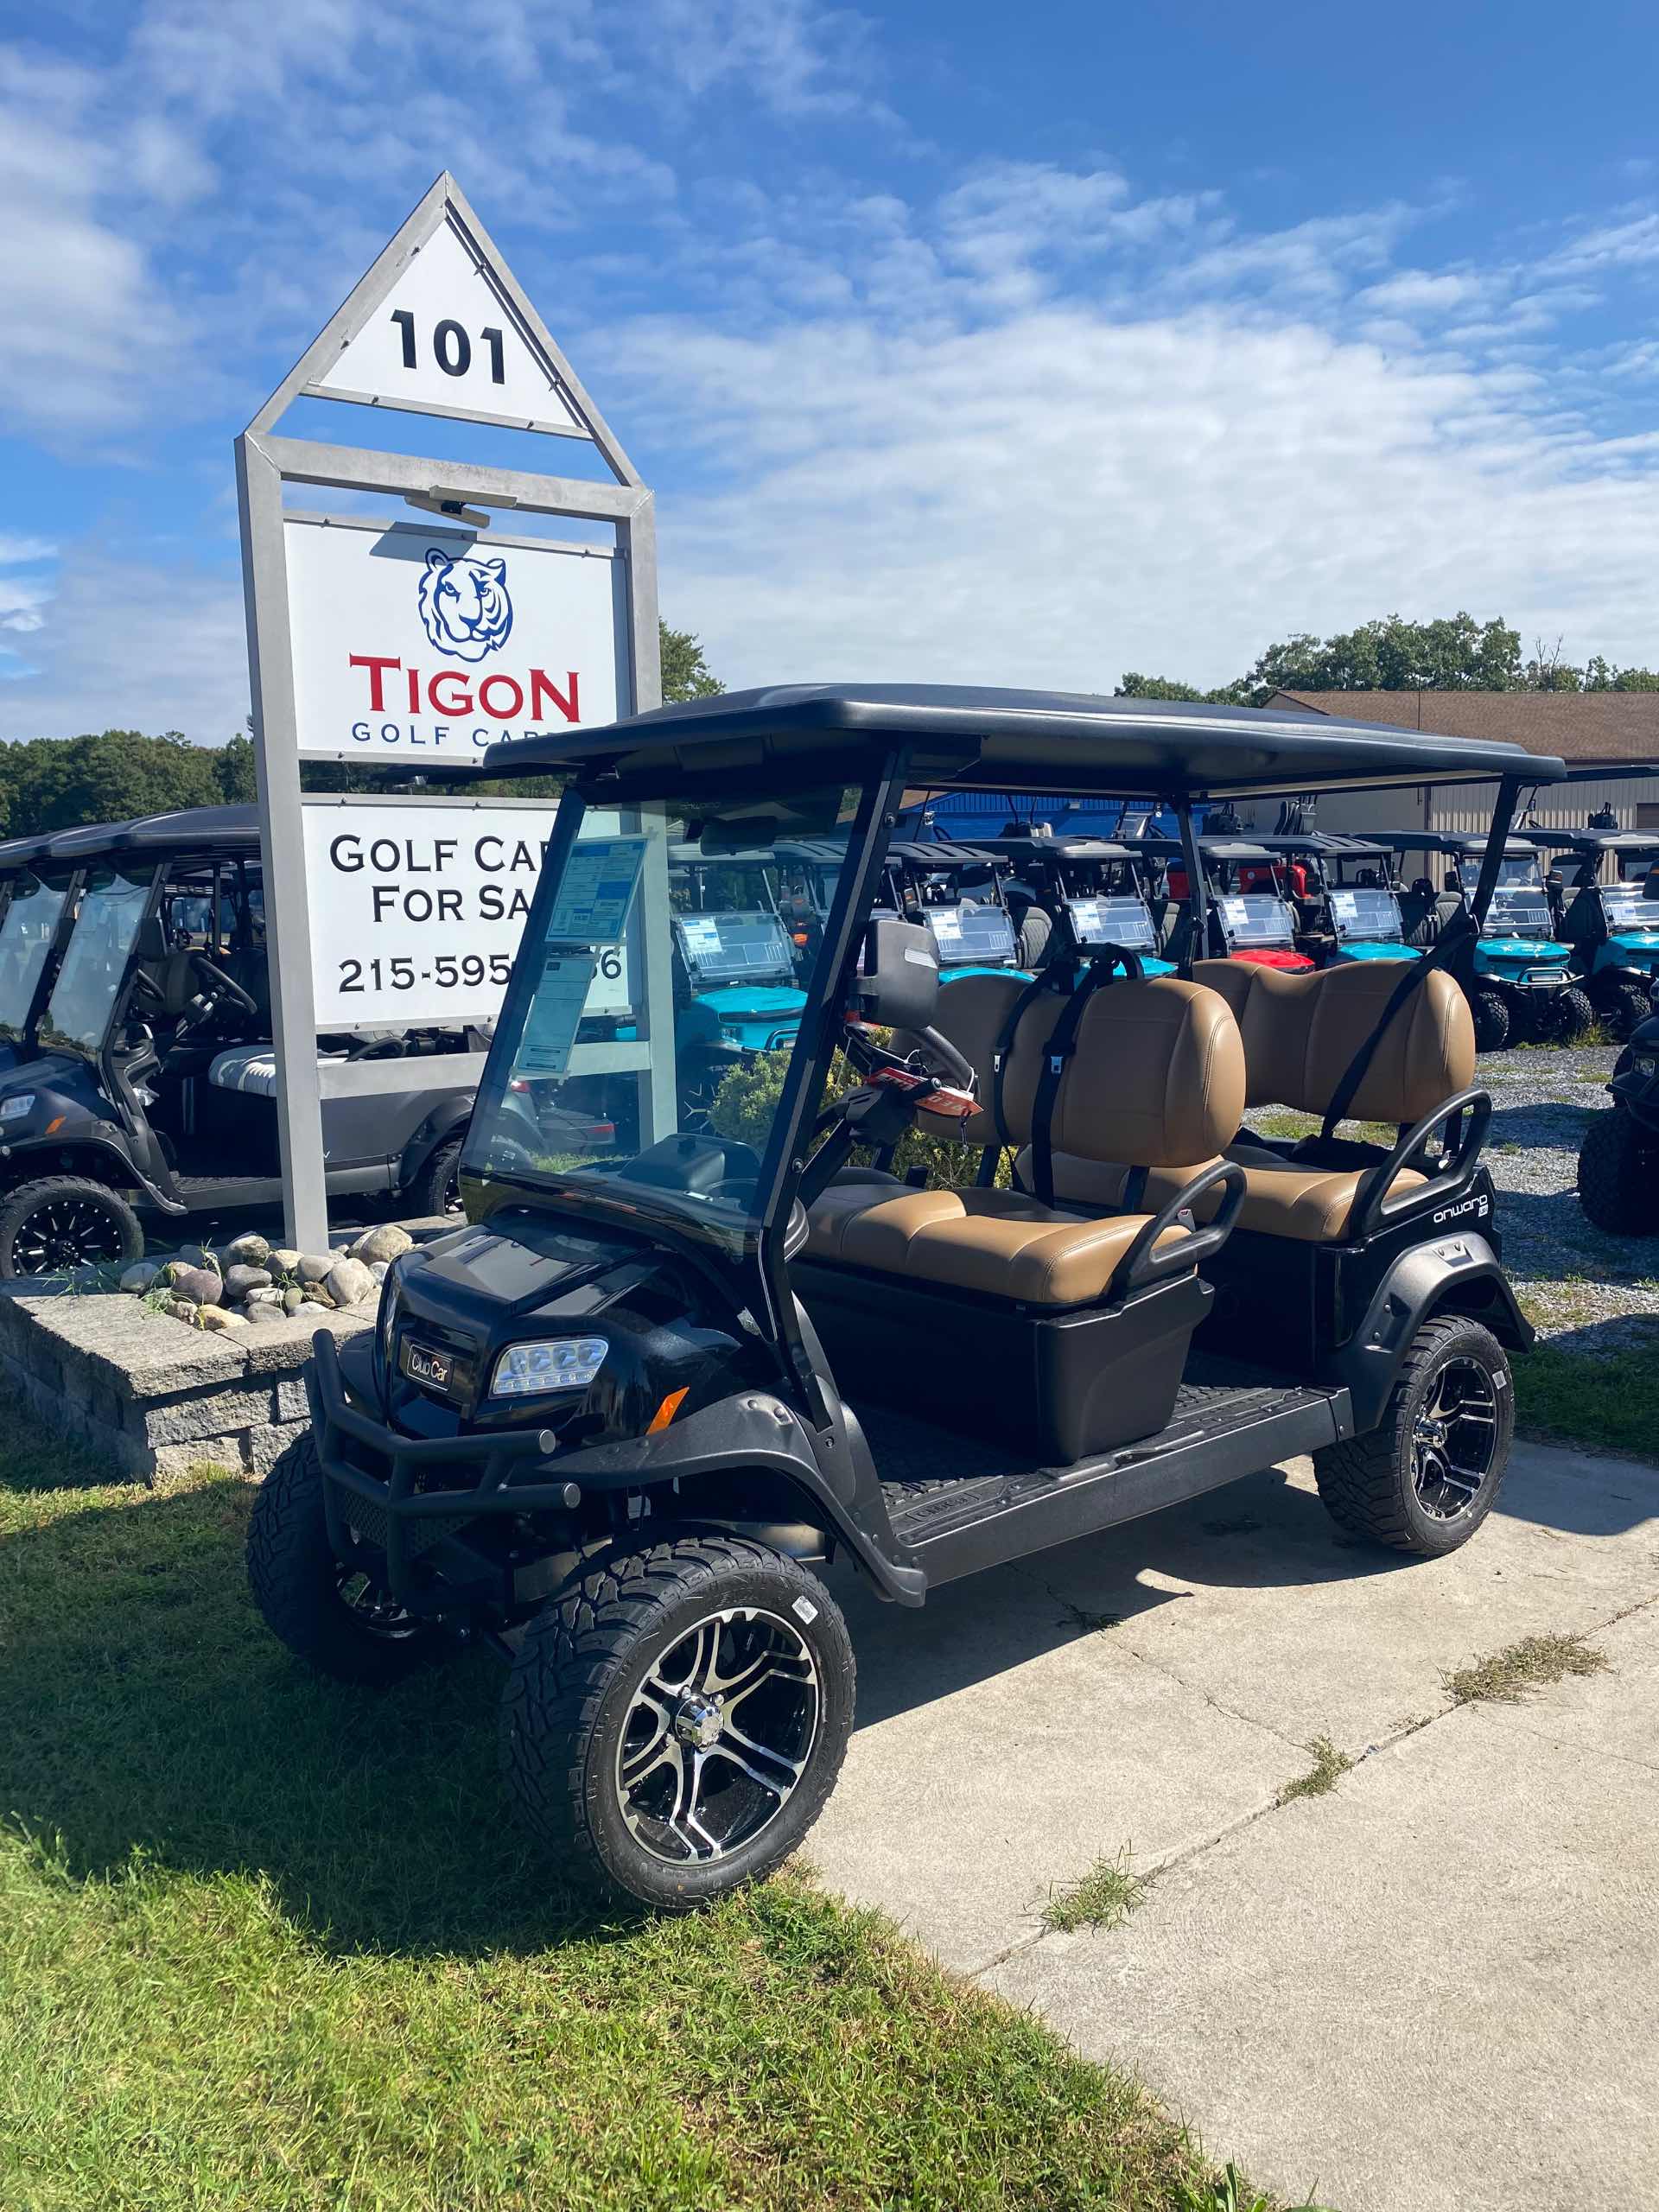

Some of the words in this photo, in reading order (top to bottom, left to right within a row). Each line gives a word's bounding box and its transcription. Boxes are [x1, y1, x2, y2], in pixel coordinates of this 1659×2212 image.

[390, 308, 505, 385] 101
[349, 652, 581, 723] TIGON
[352, 722, 450, 746] GOLF
[472, 728, 555, 747] CA
[330, 834, 458, 873] GOLF
[372, 885, 465, 923] FOR
[479, 884, 530, 920] SA
[430, 1360, 448, 1382] Car
